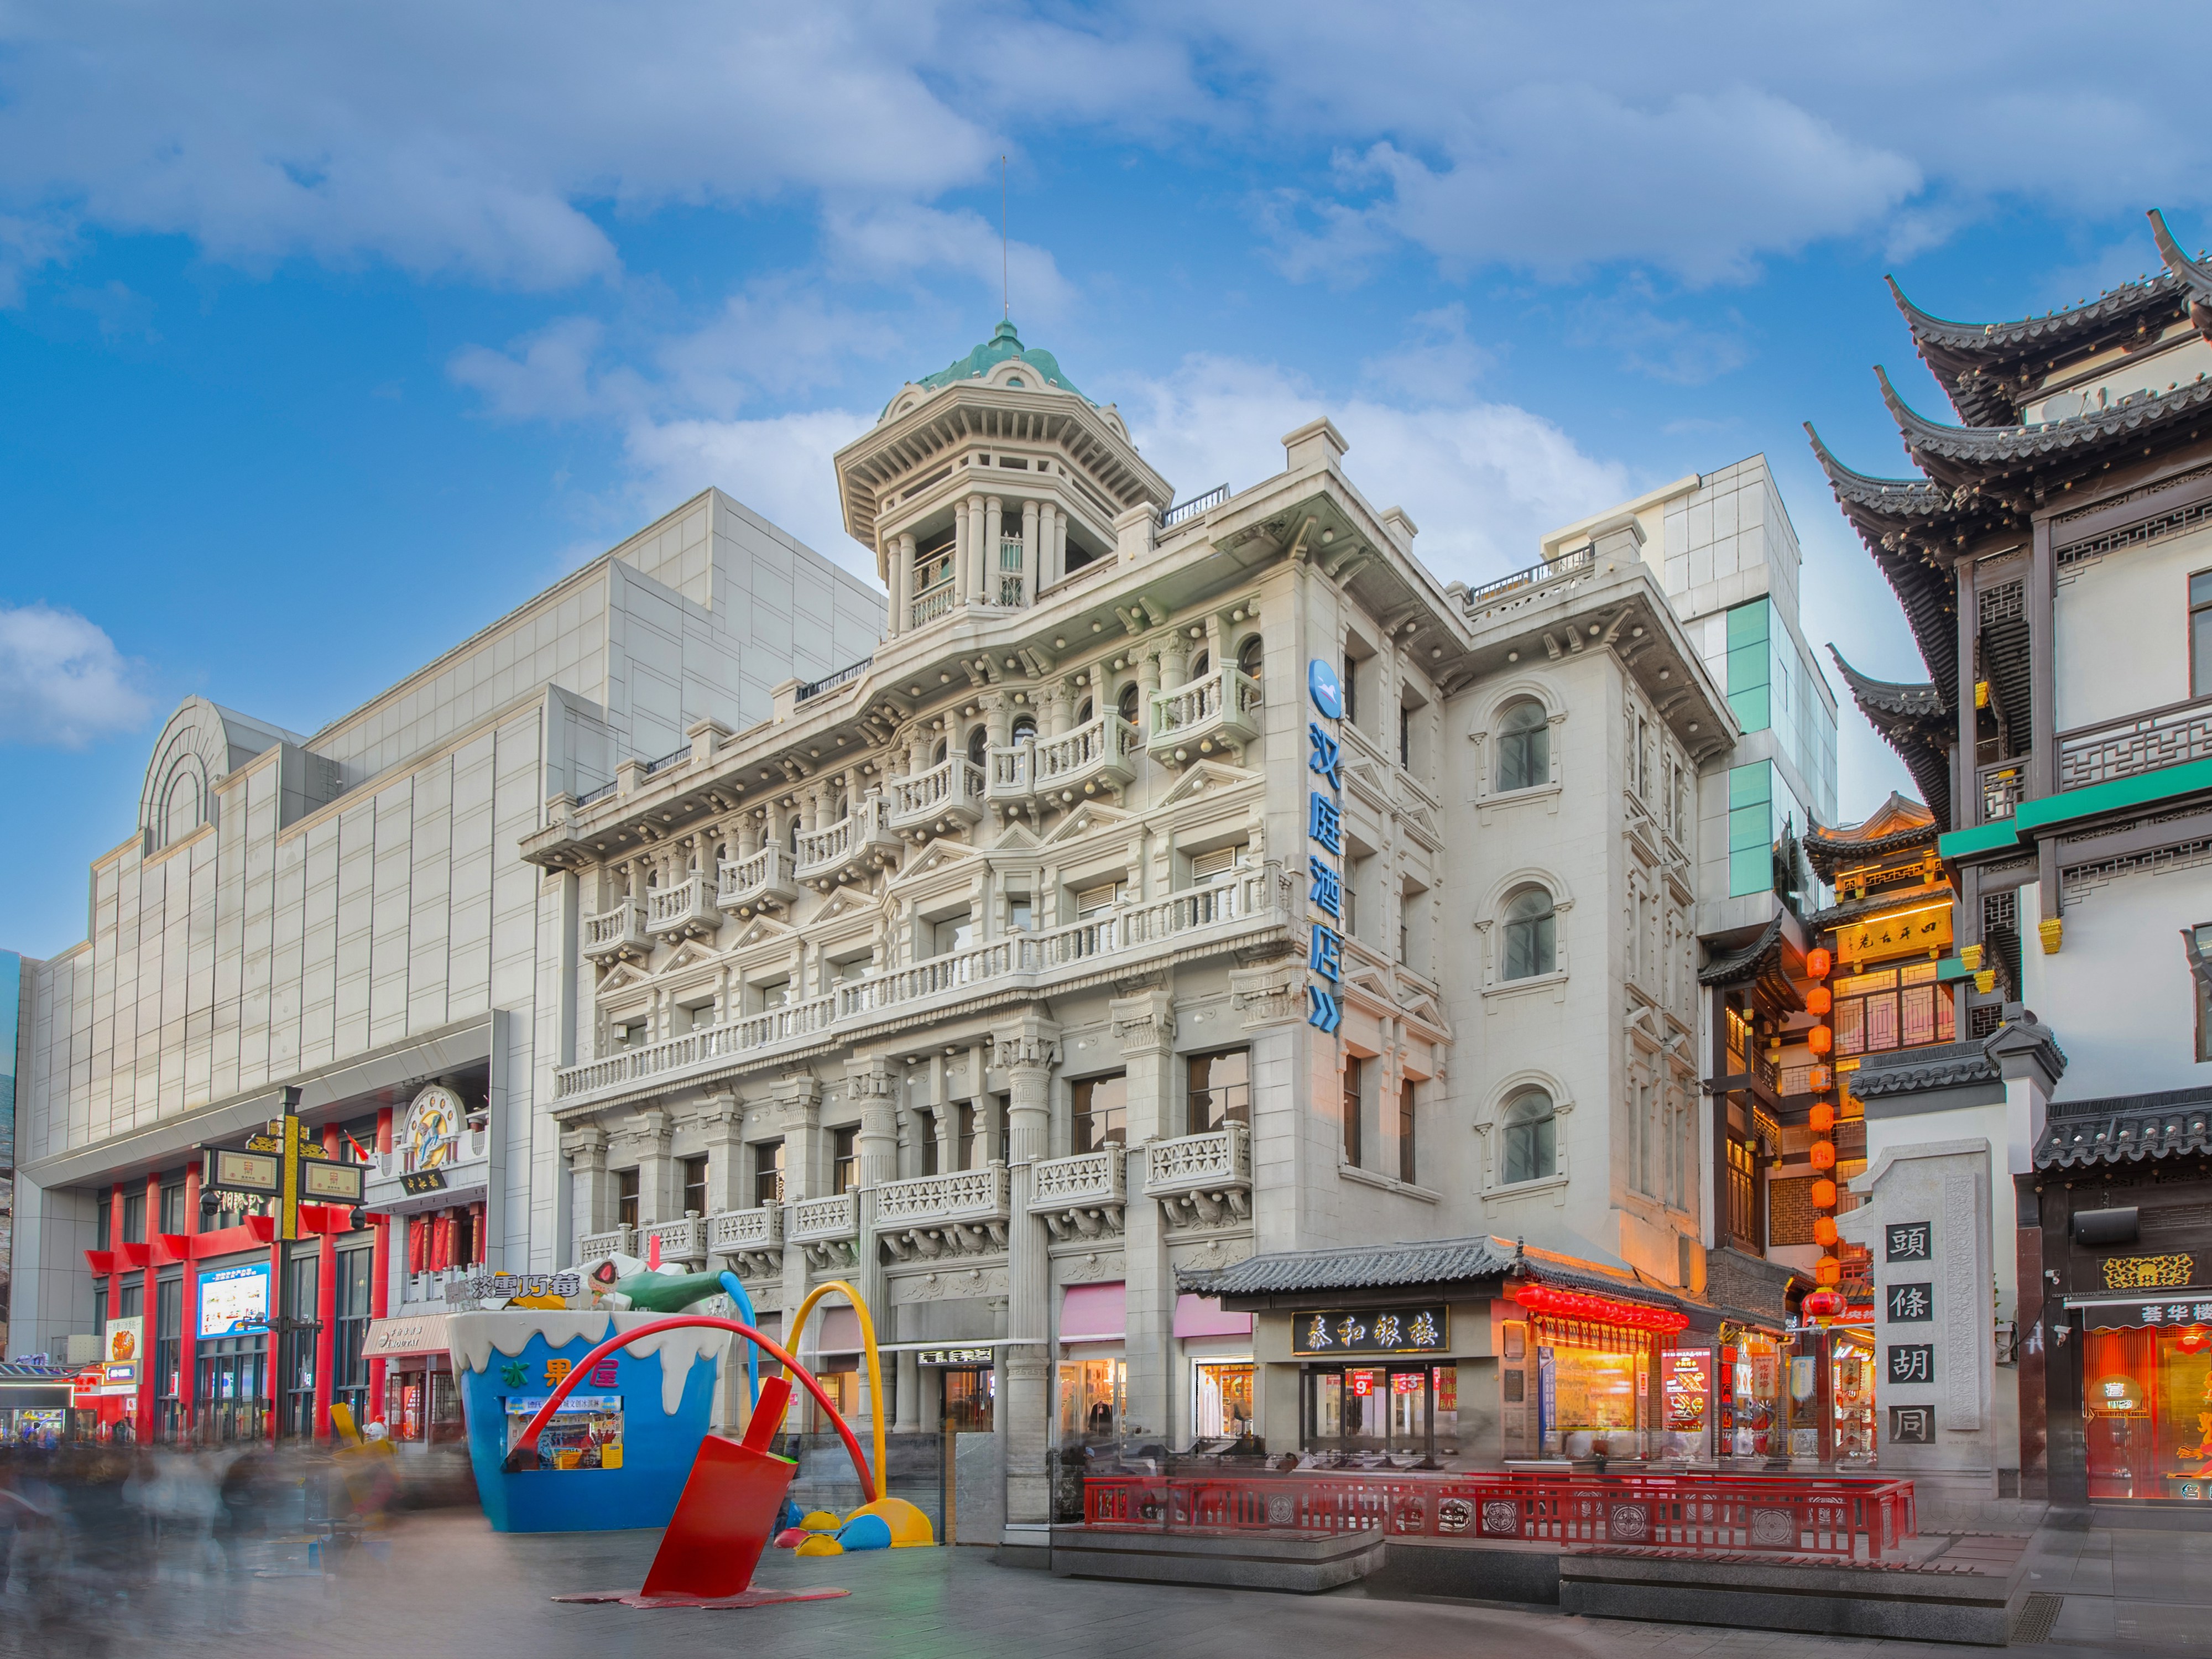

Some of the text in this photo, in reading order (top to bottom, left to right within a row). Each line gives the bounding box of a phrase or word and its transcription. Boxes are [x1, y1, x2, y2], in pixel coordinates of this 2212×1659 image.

[1309, 722, 1340, 984] 汉庭酒店
[472, 1274, 580, 1298] 淡雪巧莓
[2142, 1303, 2212, 1322] 荟华楼
[1306, 1311, 1438, 1350] 泰和银楼
[1890, 1227, 1929, 1442] 頭條胡同
[500, 1358, 619, 1388] 冰果屋
[1759, 1364, 1769, 1387] 烤猪蹄
